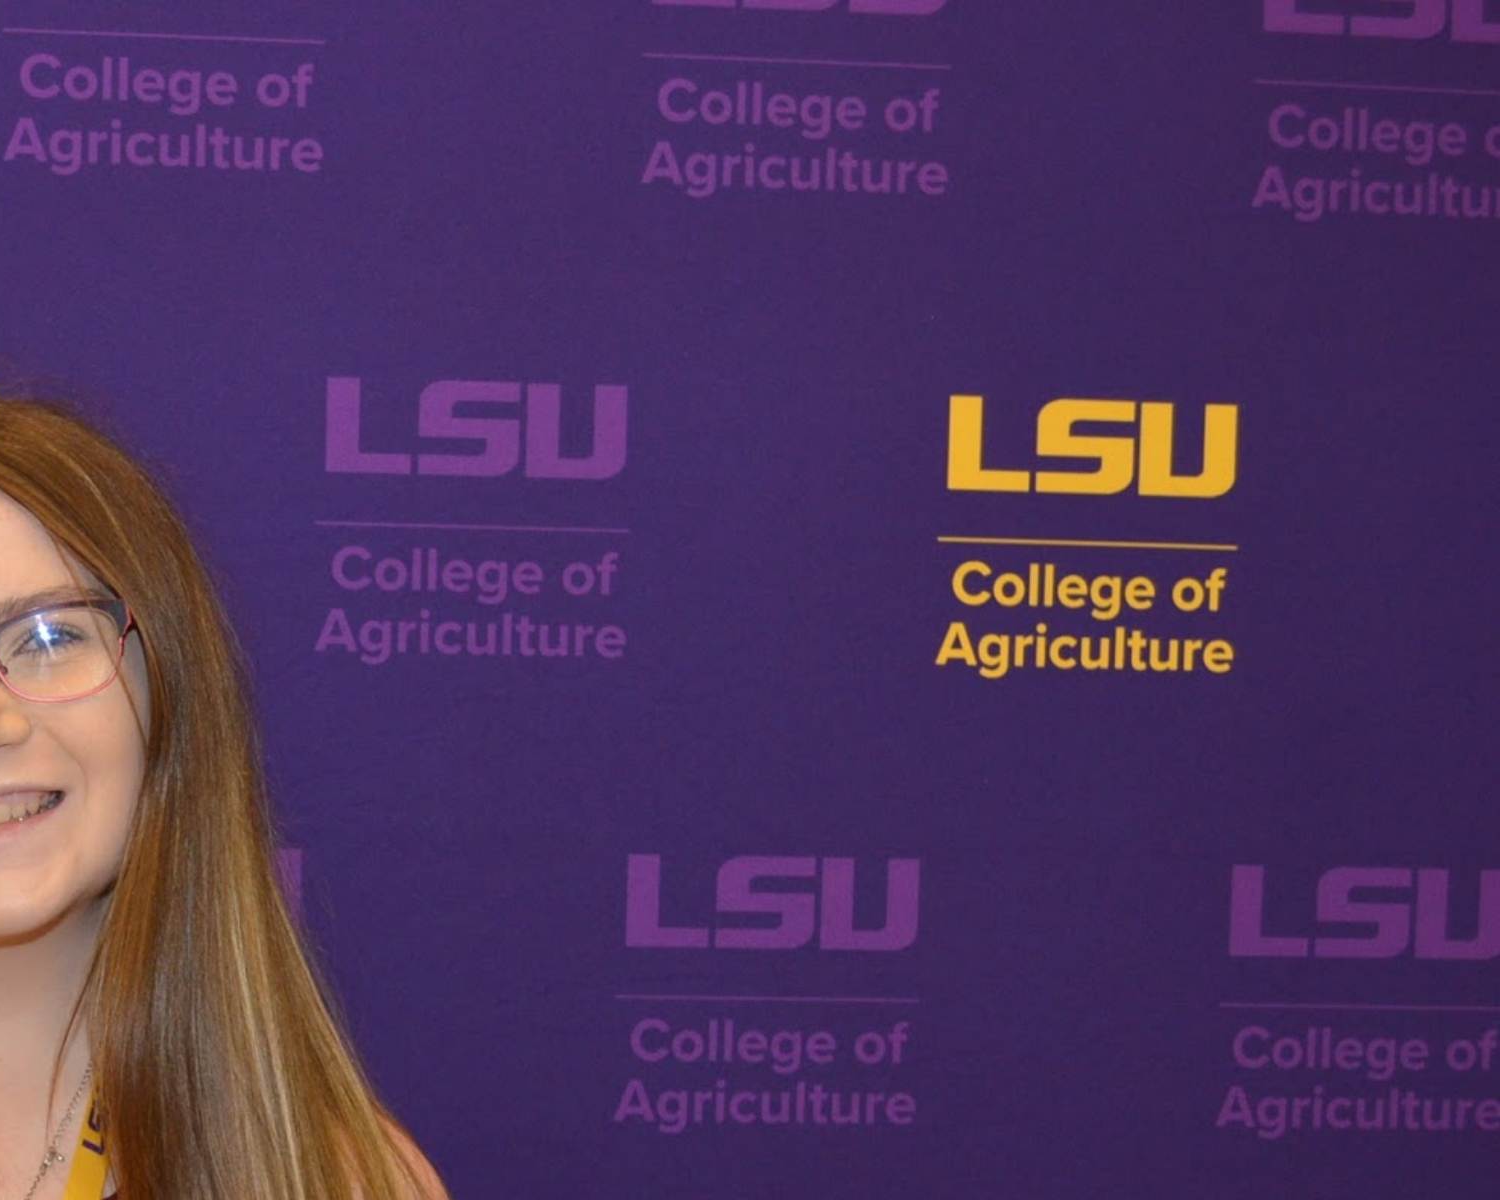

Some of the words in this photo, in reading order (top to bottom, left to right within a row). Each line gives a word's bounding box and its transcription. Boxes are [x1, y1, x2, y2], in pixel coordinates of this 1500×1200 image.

[19, 52, 239, 115] College
[256, 63, 314, 108] of
[656, 76, 867, 141] College
[883, 88, 940, 133] of
[4, 116, 324, 176] Agriculture
[1264, 102, 1468, 167] College
[641, 140, 949, 199] Agriculture
[325, 376, 628, 480] LSU
[946, 394, 1238, 498] LSU
[331, 545, 544, 605] College
[561, 551, 619, 597] of
[951, 560, 1156, 616] College
[1172, 567, 1227, 612] of
[315, 607, 627, 666] Agriculture
[935, 621, 1234, 679] Agriculture
[625, 853, 921, 951] LSU
[1228, 864, 1500, 960] LSU
[629, 1017, 836, 1075] College
[854, 1021, 909, 1065] of
[1232, 1024, 1430, 1081] College
[1445, 1028, 1498, 1072] of
[614, 1078, 916, 1134] Agriculture
[1215, 1084, 1500, 1140] Agriculture
